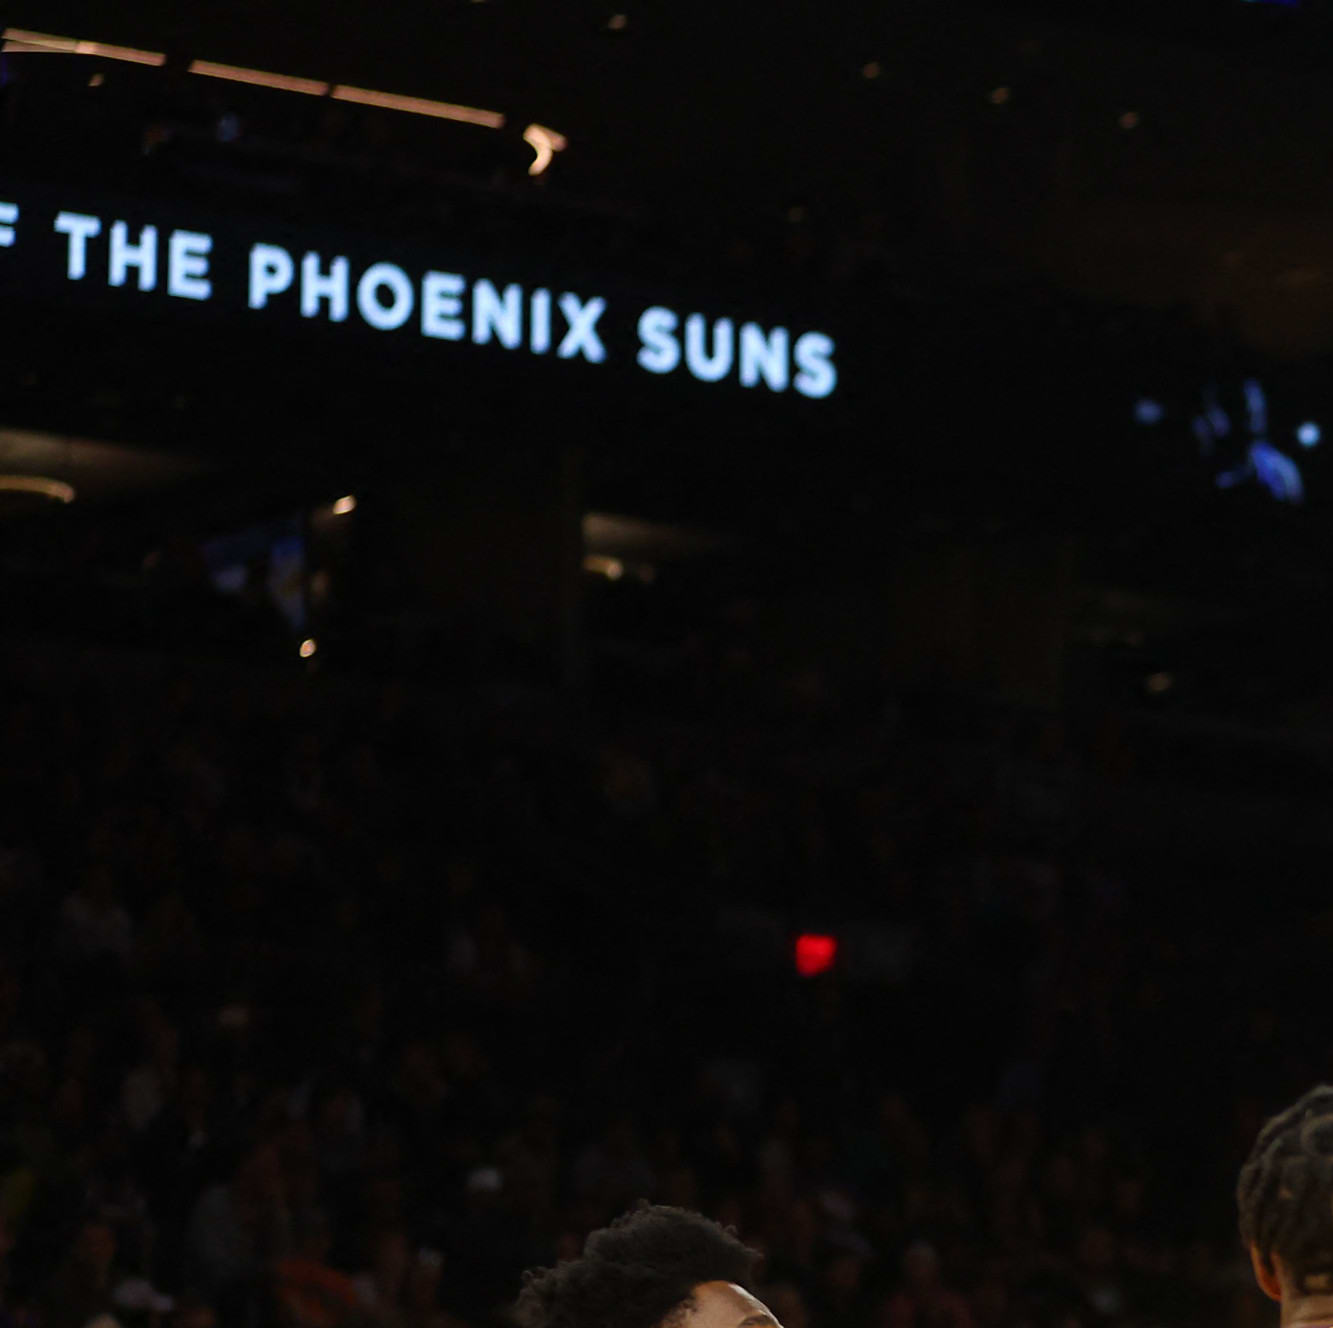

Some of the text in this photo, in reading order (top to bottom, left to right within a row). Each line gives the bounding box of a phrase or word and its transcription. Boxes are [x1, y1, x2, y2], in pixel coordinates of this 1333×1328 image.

[56, 211, 213, 300] THE
[249, 243, 607, 363] PHOENIX
[637, 307, 837, 398] SUNS
